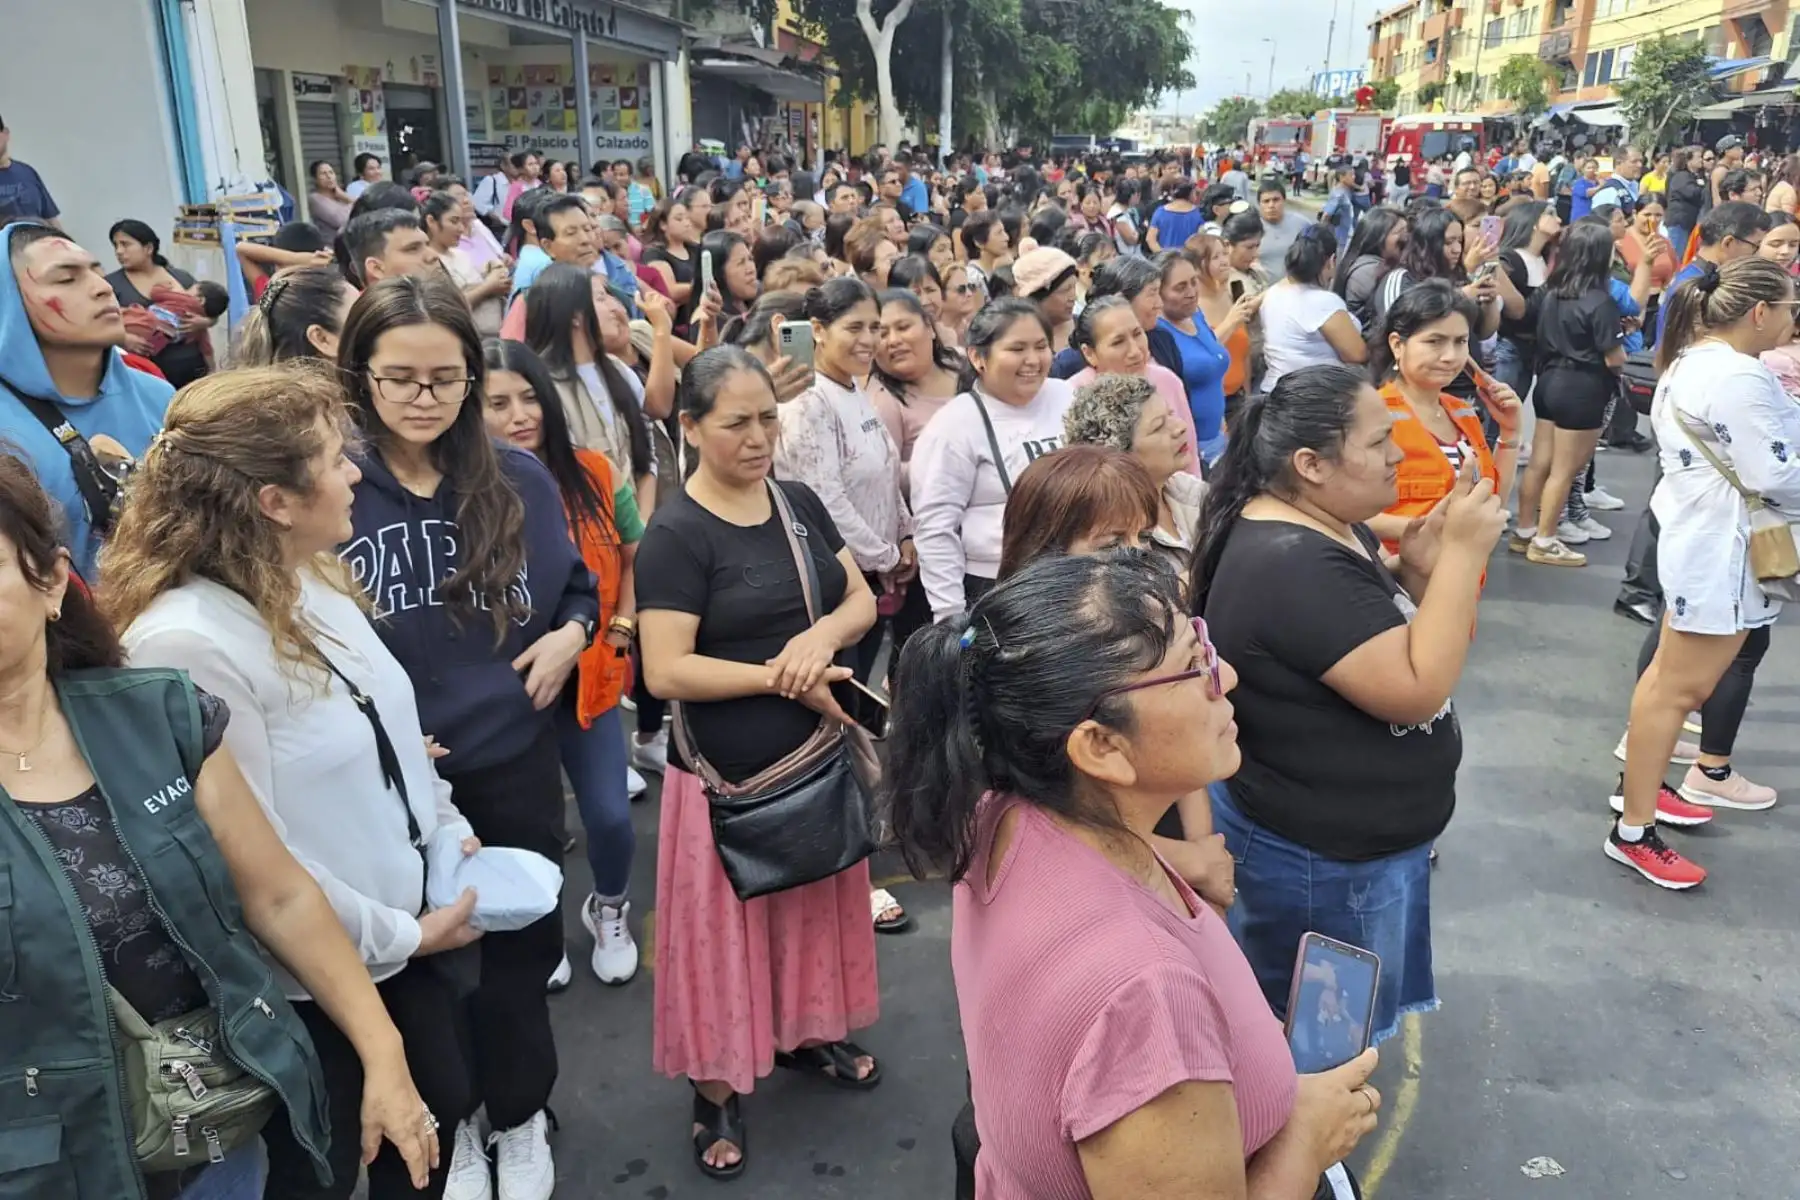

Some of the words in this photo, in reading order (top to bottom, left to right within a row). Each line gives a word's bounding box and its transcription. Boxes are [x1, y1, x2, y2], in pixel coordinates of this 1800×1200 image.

[551, 1, 605, 35] Calzado
[505, 135, 517, 149] El
[522, 135, 570, 149] Palacio
[596, 136, 649, 150] Calzado
[338, 519, 532, 627] PARS
